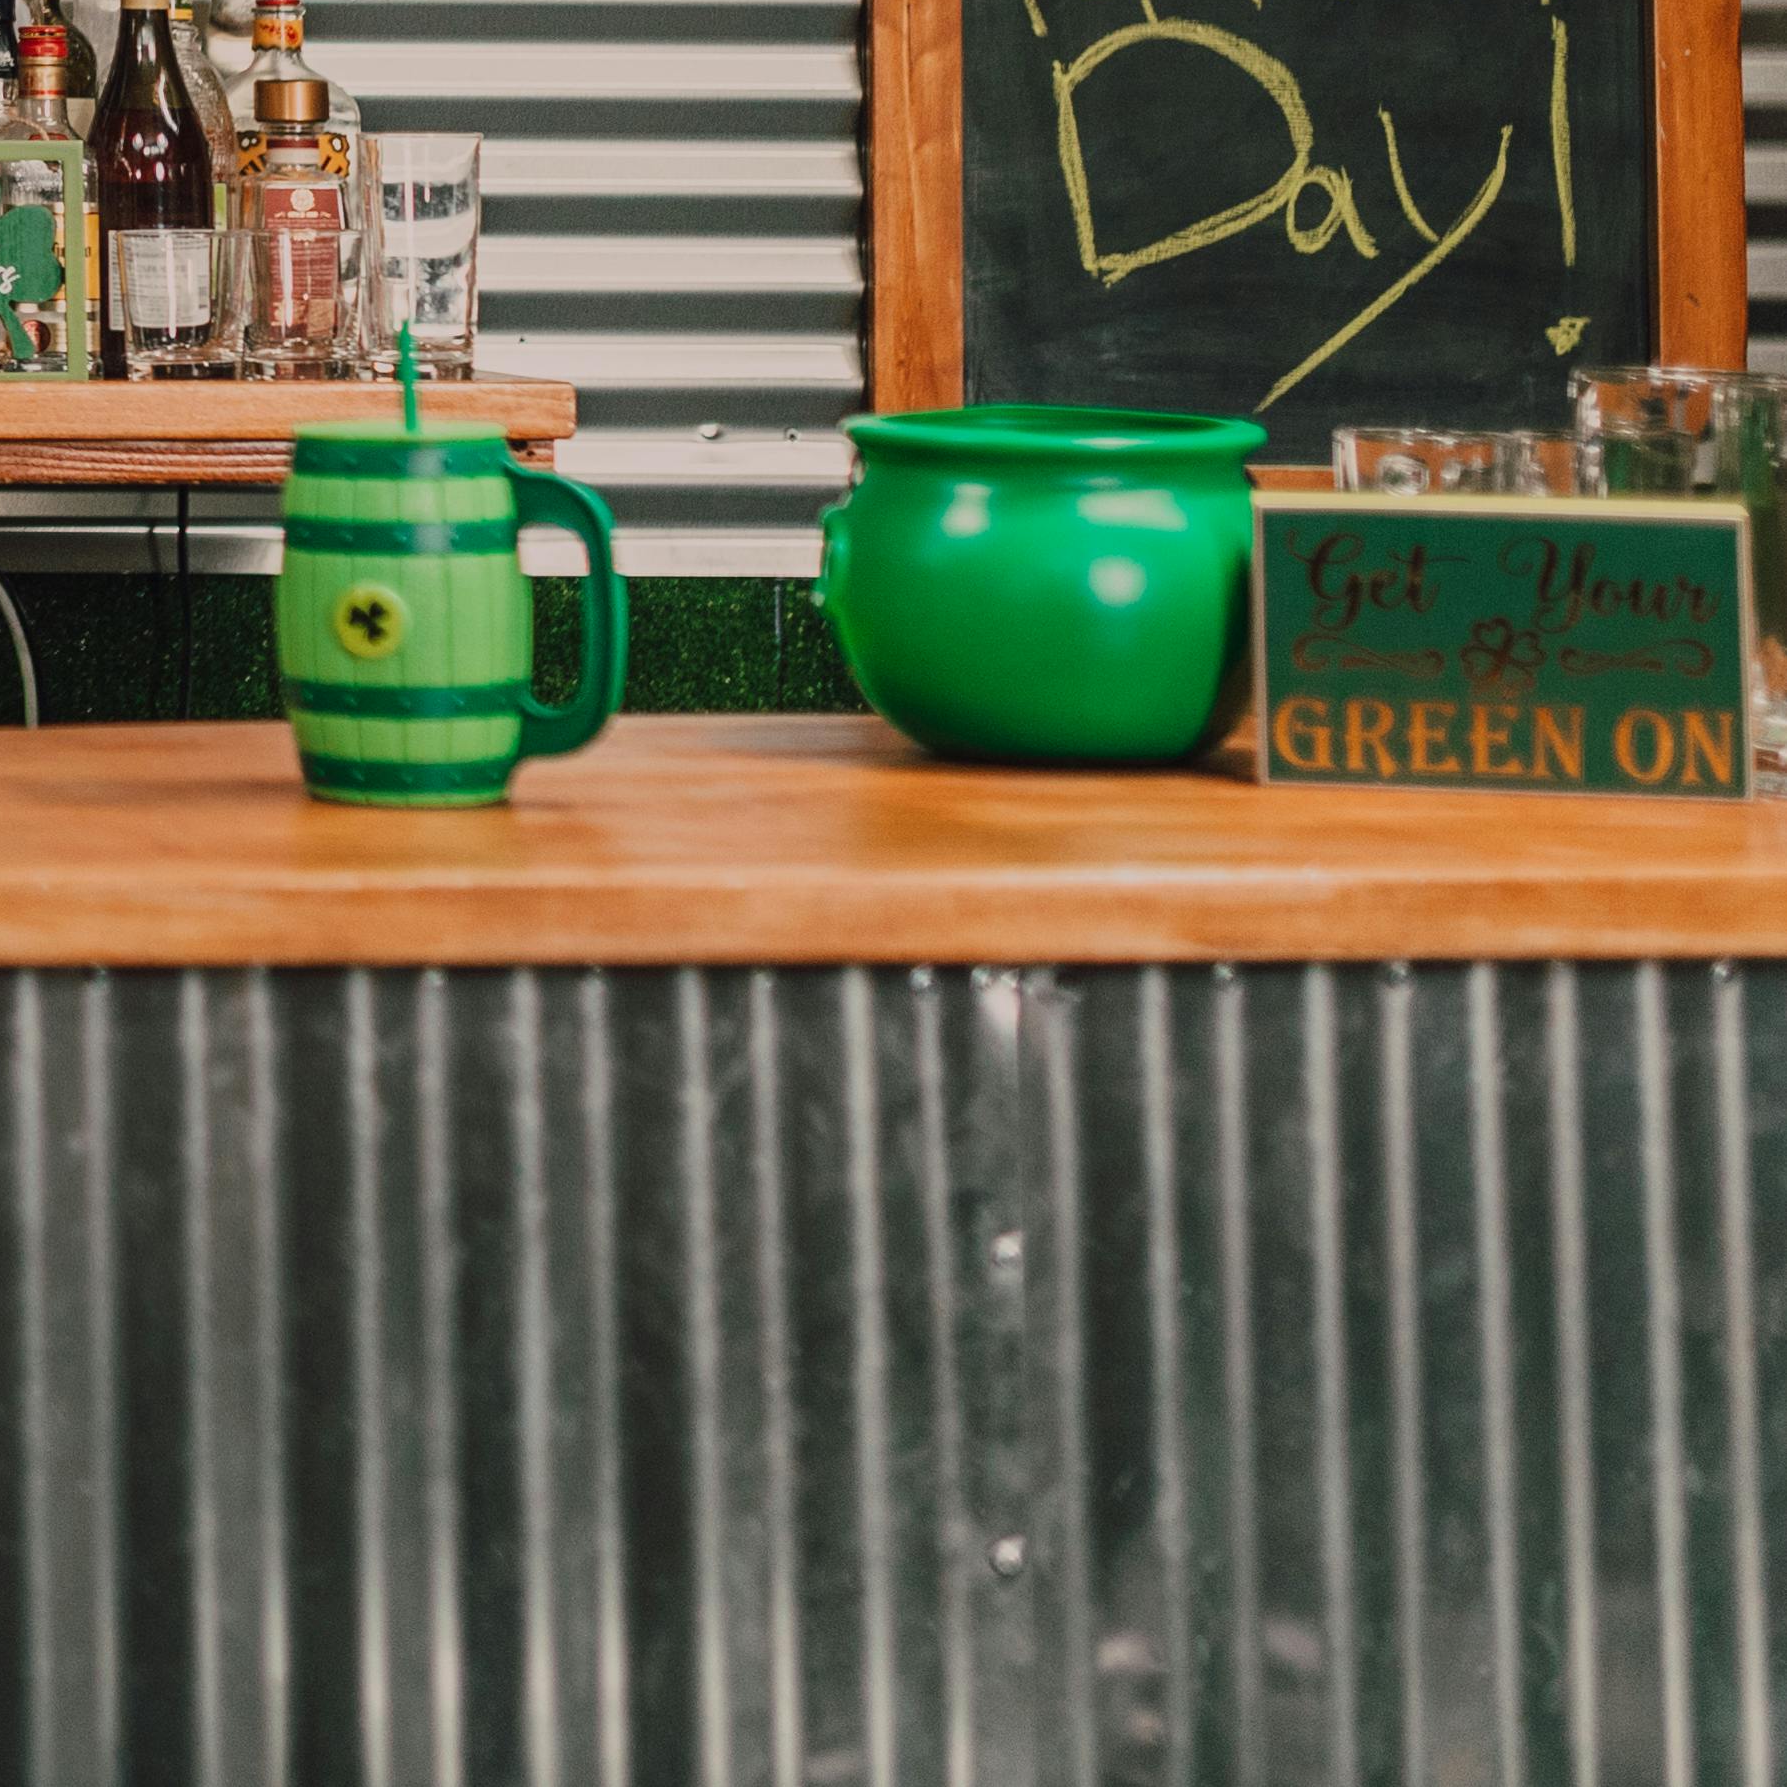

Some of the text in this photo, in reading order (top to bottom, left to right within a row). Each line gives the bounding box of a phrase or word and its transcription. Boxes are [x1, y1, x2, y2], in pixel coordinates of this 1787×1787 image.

[1052, 14, 1592, 414] Day!
[1284, 529, 1727, 635] Get Your
[1271, 692, 1736, 786] GREEN ON
